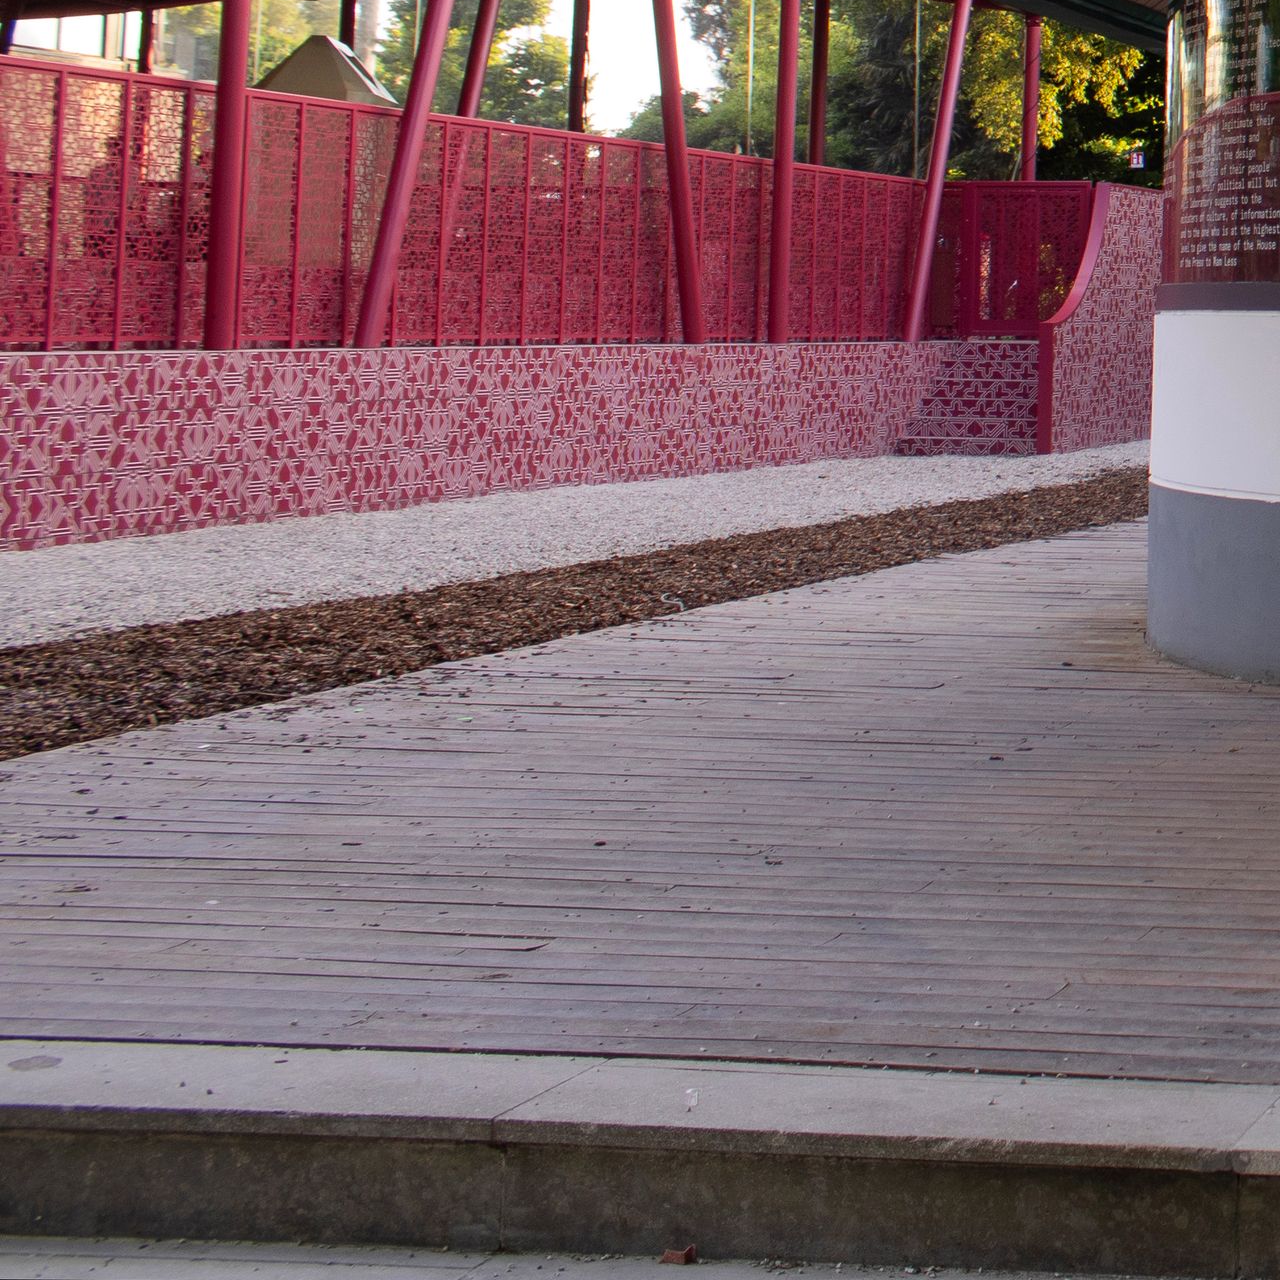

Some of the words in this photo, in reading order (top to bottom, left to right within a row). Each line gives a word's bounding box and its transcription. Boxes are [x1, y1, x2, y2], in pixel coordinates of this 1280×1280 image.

[1249, 101, 1268, 112] their
[1235, 148, 1256, 160] design
[1248, 161, 1270, 177] people
[1217, 178, 1244, 191] political
[1248, 177, 1262, 189] will
[1265, 178, 1278, 188] but
[1251, 193, 1262, 204] the
[1240, 207, 1280, 220] information
[1240, 224, 1251, 235] the
[1253, 223, 1280, 237] highest
[1243, 240, 1254, 250] the
[1256, 240, 1277, 250] House
[1224, 256, 1237, 266] Less
